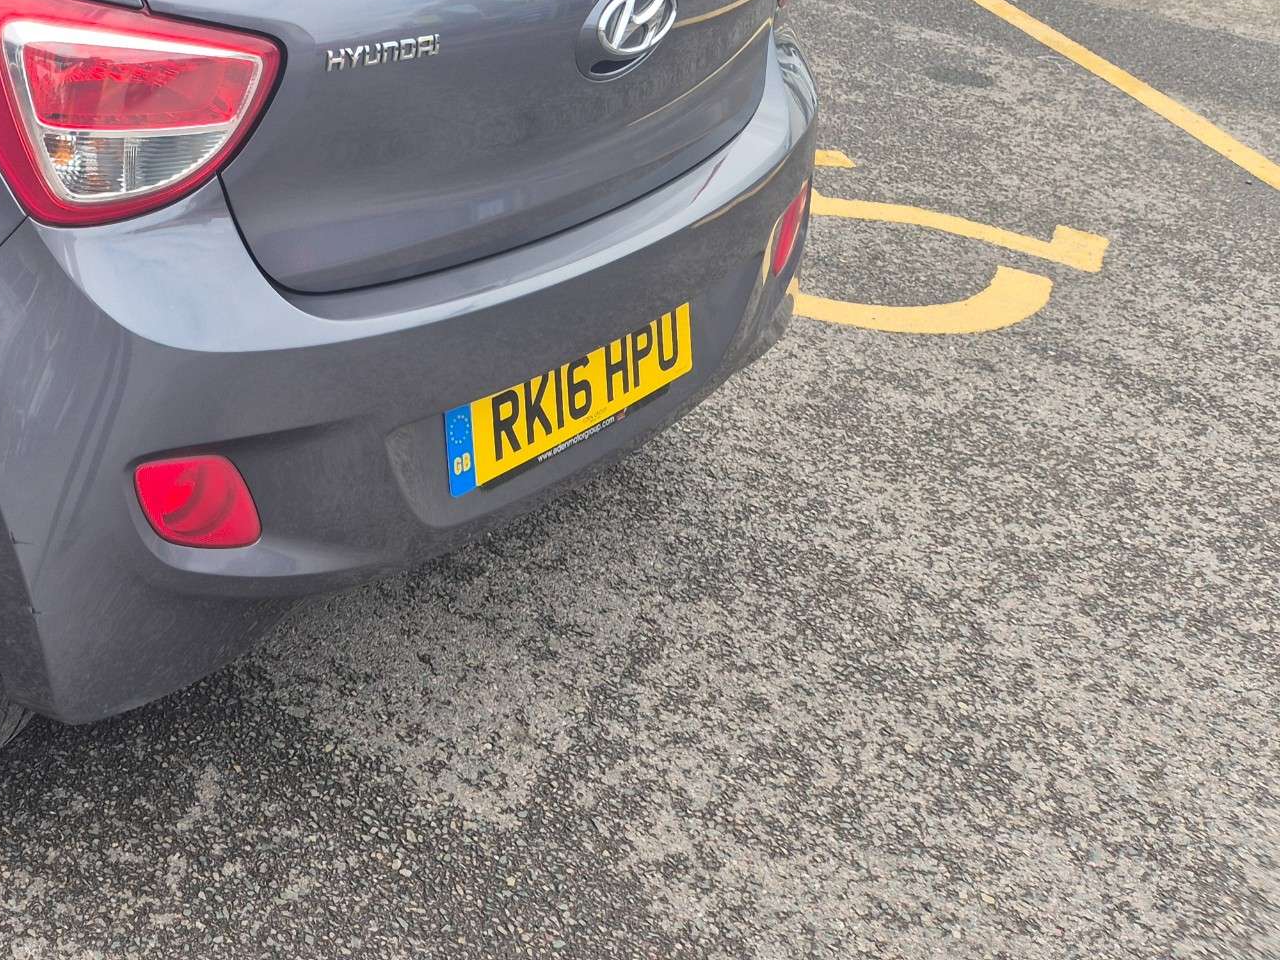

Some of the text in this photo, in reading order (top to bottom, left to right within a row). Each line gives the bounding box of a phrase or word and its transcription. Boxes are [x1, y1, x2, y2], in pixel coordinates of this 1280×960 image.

[324, 33, 440, 72] HYUNDAI
[491, 311, 679, 462] RK16 HPU
[453, 452, 472, 476] GB
